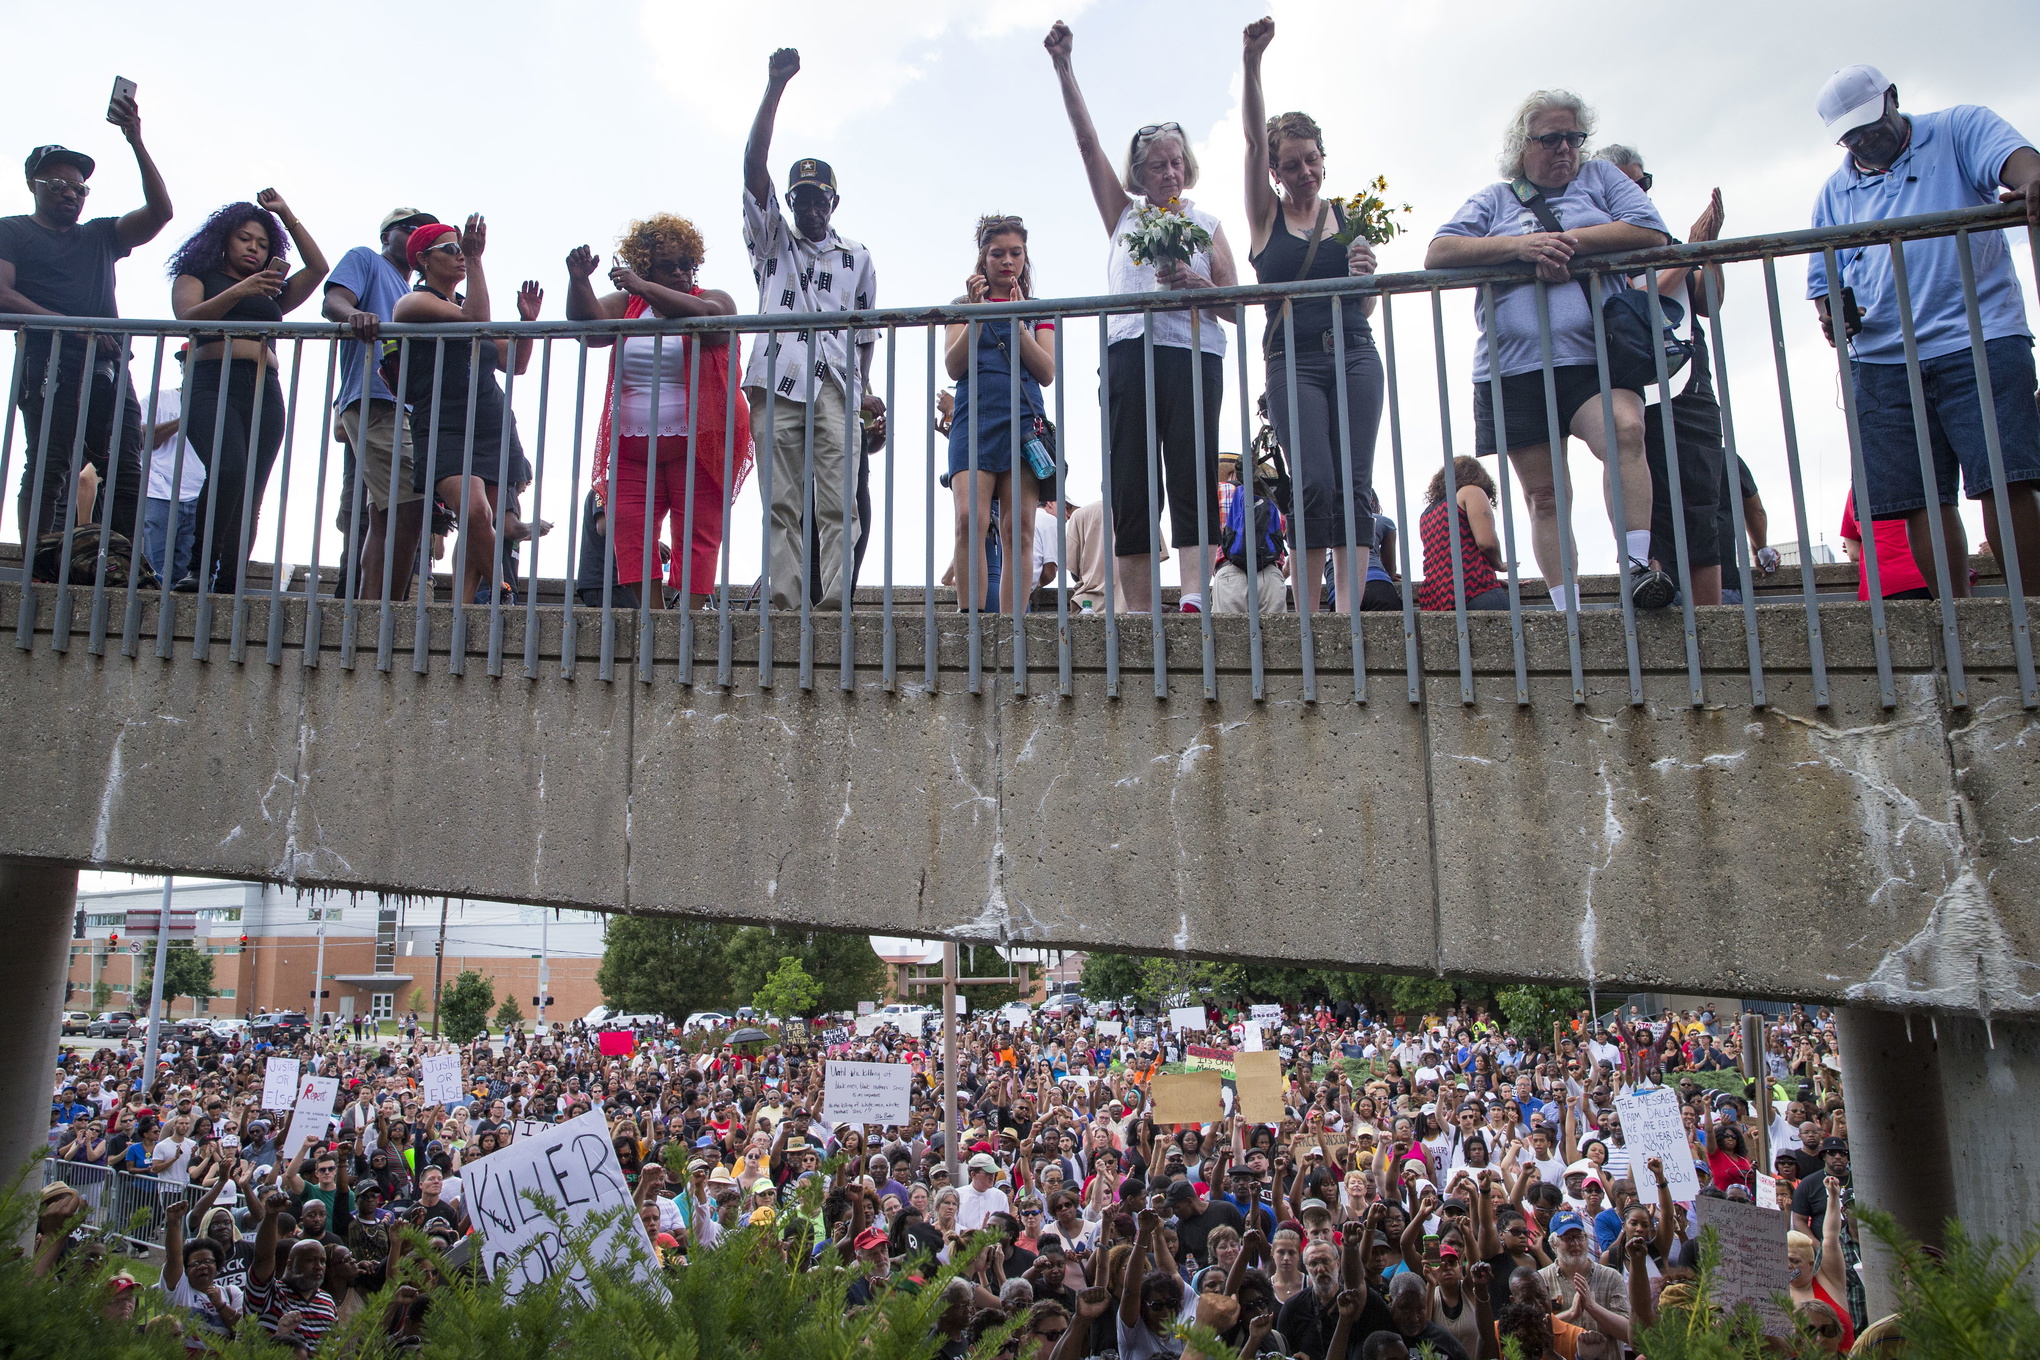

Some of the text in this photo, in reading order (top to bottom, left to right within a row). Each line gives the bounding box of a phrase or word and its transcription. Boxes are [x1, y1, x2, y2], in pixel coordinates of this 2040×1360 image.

[788, 1030, 806, 1038] LIVES
[276, 1074, 289, 1086] OR
[436, 1072, 453, 1082] OR
[862, 1070, 880, 1080] killing
[884, 1070, 892, 1078] of
[266, 1090, 294, 1106] ELSE
[430, 1084, 462, 1102] ELSE
[1616, 1092, 1677, 1110] THE MESSAGE
[1622, 1106, 1680, 1122] FROM DALLAS
[522, 1122, 536, 1136] I
[1626, 1124, 1637, 1134] WE
[1658, 1120, 1671, 1130] FED
[1672, 1118, 1681, 1128] UP
[1628, 1134, 1639, 1146] DO
[1642, 1132, 1656, 1144] YOU
[1672, 1128, 1684, 1140] US
[1656, 1152, 1674, 1162] AM
[1642, 1172, 1692, 1188] JOSON
[471, 1134, 636, 1241] KILLER
[1706, 1200, 1714, 1212] I
[1744, 1208, 1752, 1218] A
[1756, 1208, 1780, 1220] Proud
[1736, 1222, 1770, 1234] Mother
[1742, 1234, 1758, 1242] two
[1756, 1244, 1774, 1252] Men
[1756, 1262, 1774, 1270] law
